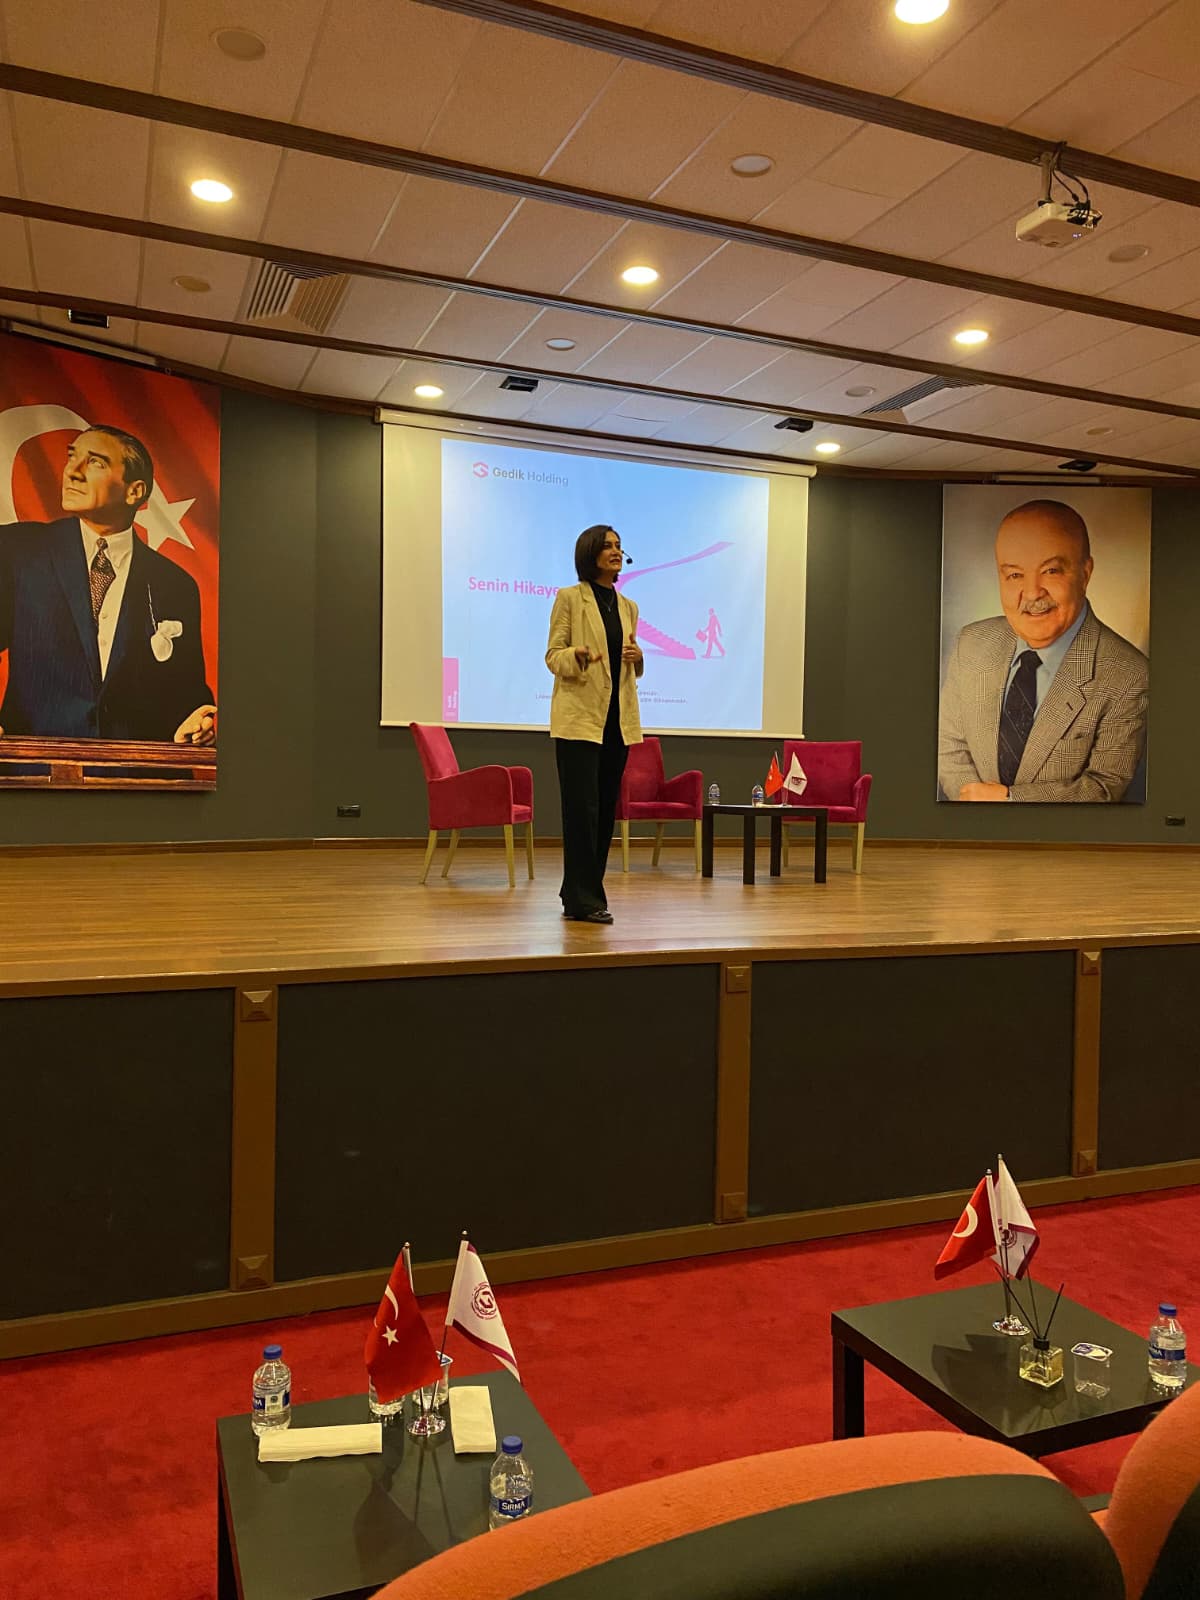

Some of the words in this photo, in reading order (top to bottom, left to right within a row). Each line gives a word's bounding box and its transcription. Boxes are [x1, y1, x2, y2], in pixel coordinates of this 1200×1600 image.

[492, 467, 525, 481] Gedik
[527, 471, 569, 487] Holding
[468, 577, 510, 593] Senin
